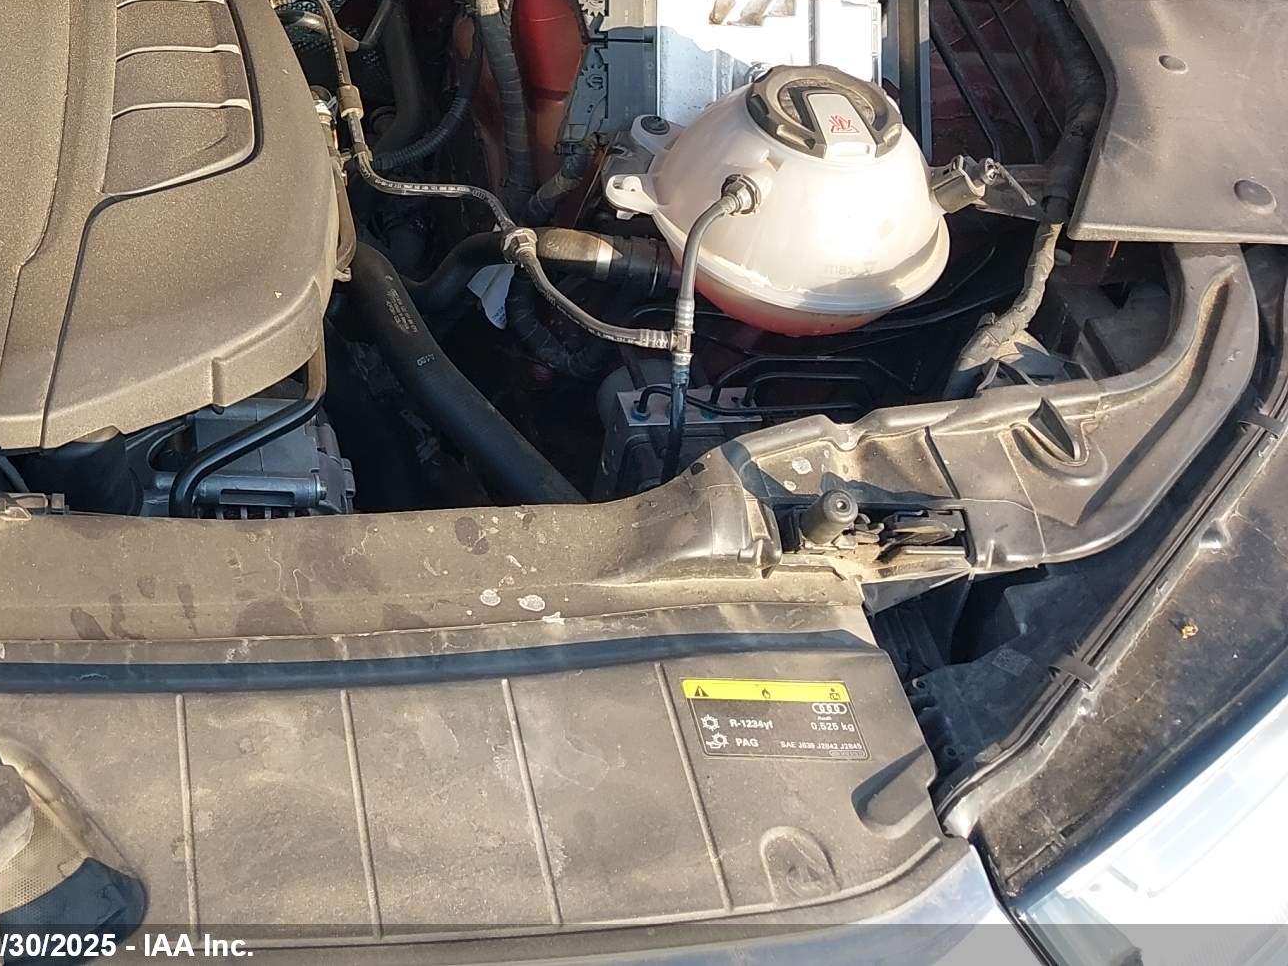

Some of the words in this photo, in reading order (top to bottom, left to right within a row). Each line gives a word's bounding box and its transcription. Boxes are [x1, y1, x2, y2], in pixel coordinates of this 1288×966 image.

[729, 718, 774, 730] R-1234yf
[840, 721, 856, 733] kg
[735, 737, 760, 748] PAG
